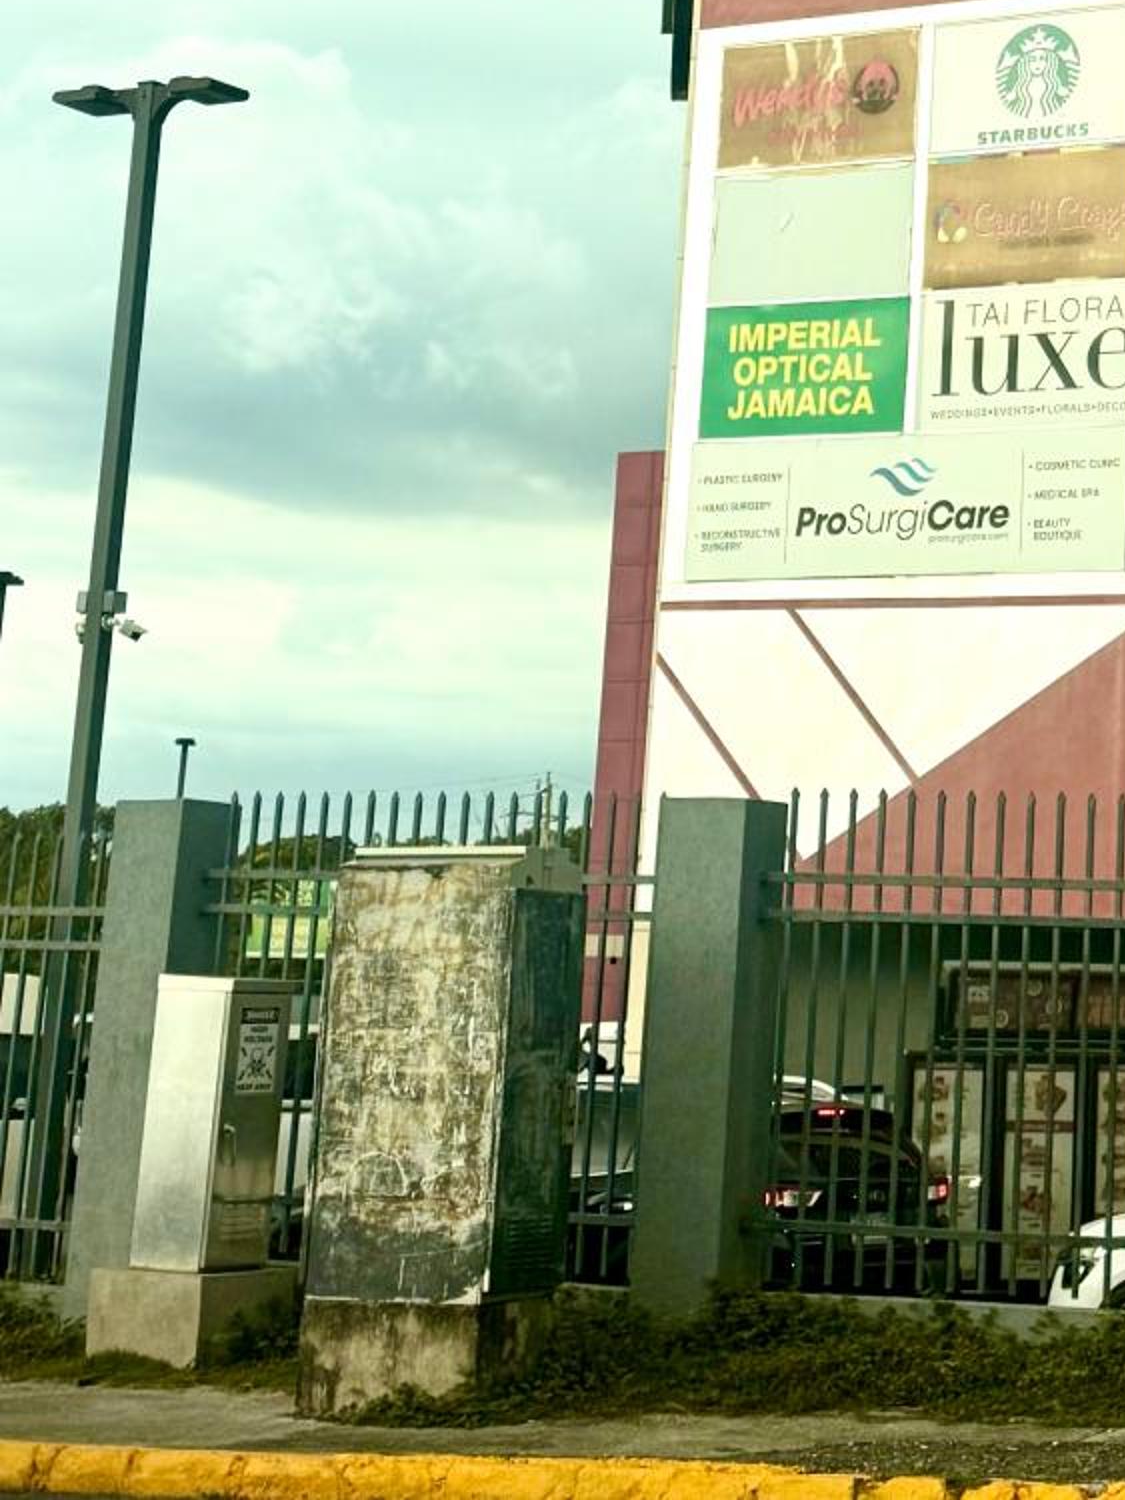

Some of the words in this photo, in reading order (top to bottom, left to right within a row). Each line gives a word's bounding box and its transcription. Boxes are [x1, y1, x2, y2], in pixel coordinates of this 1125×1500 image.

[977, 122, 1089, 145] STARBUCKS
[965, 302, 1009, 327] TAI
[1023, 295, 1124, 325] FLORA
[729, 318, 882, 353] IMPERIAL
[733, 352, 873, 387] OPTICAL
[728, 385, 874, 420] JAMAICA
[795, 499, 1010, 541] ProSurgiCare
